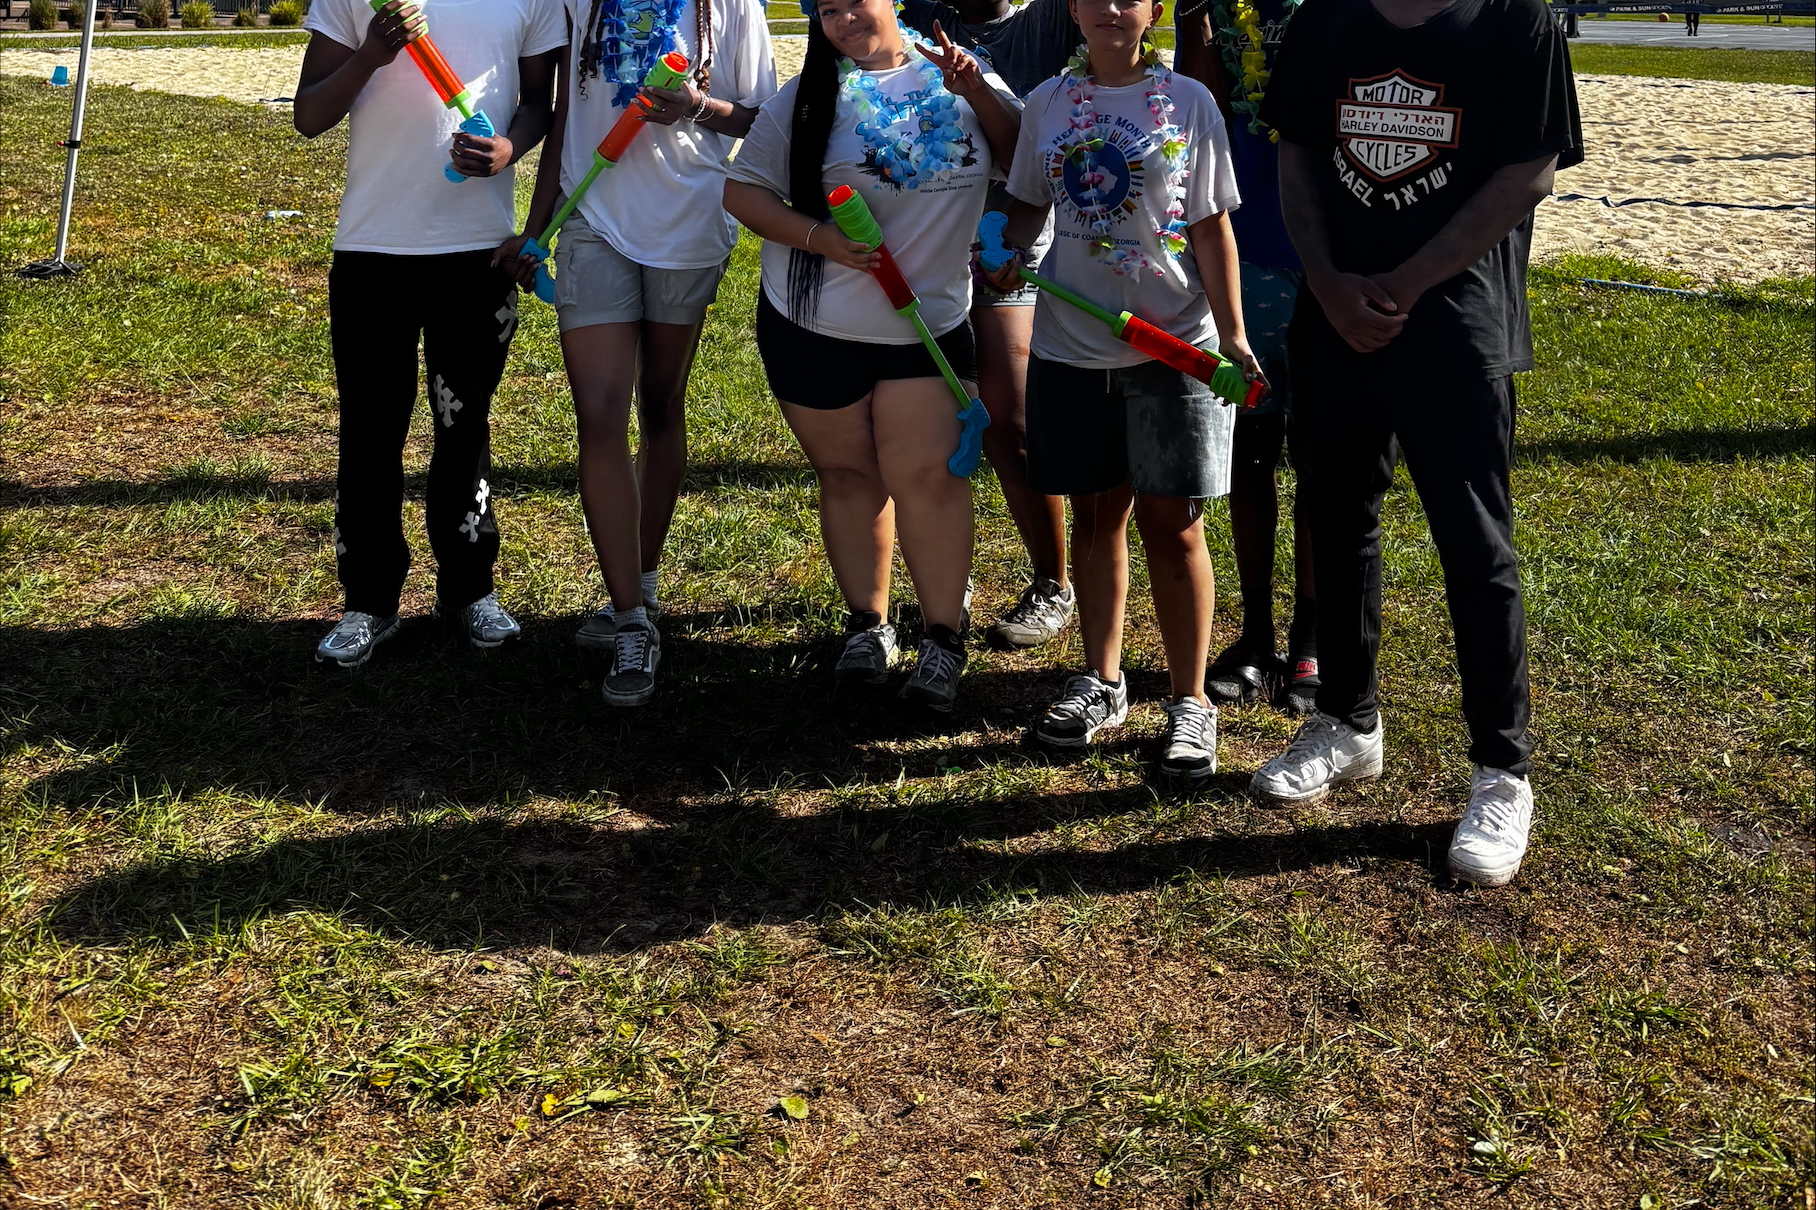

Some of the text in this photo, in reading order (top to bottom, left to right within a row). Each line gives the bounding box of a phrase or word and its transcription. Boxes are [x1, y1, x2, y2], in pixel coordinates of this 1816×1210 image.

[1362, 80, 1424, 104] MOTOR
[1114, 116, 1152, 149] MONTH
[1381, 123, 1444, 138] DAVIDSON
[1356, 141, 1417, 171] CYCLES
[1333, 146, 1374, 208] ISRAEL
[1383, 161, 1453, 211] ישראל
[1072, 232, 1080, 240] OF
